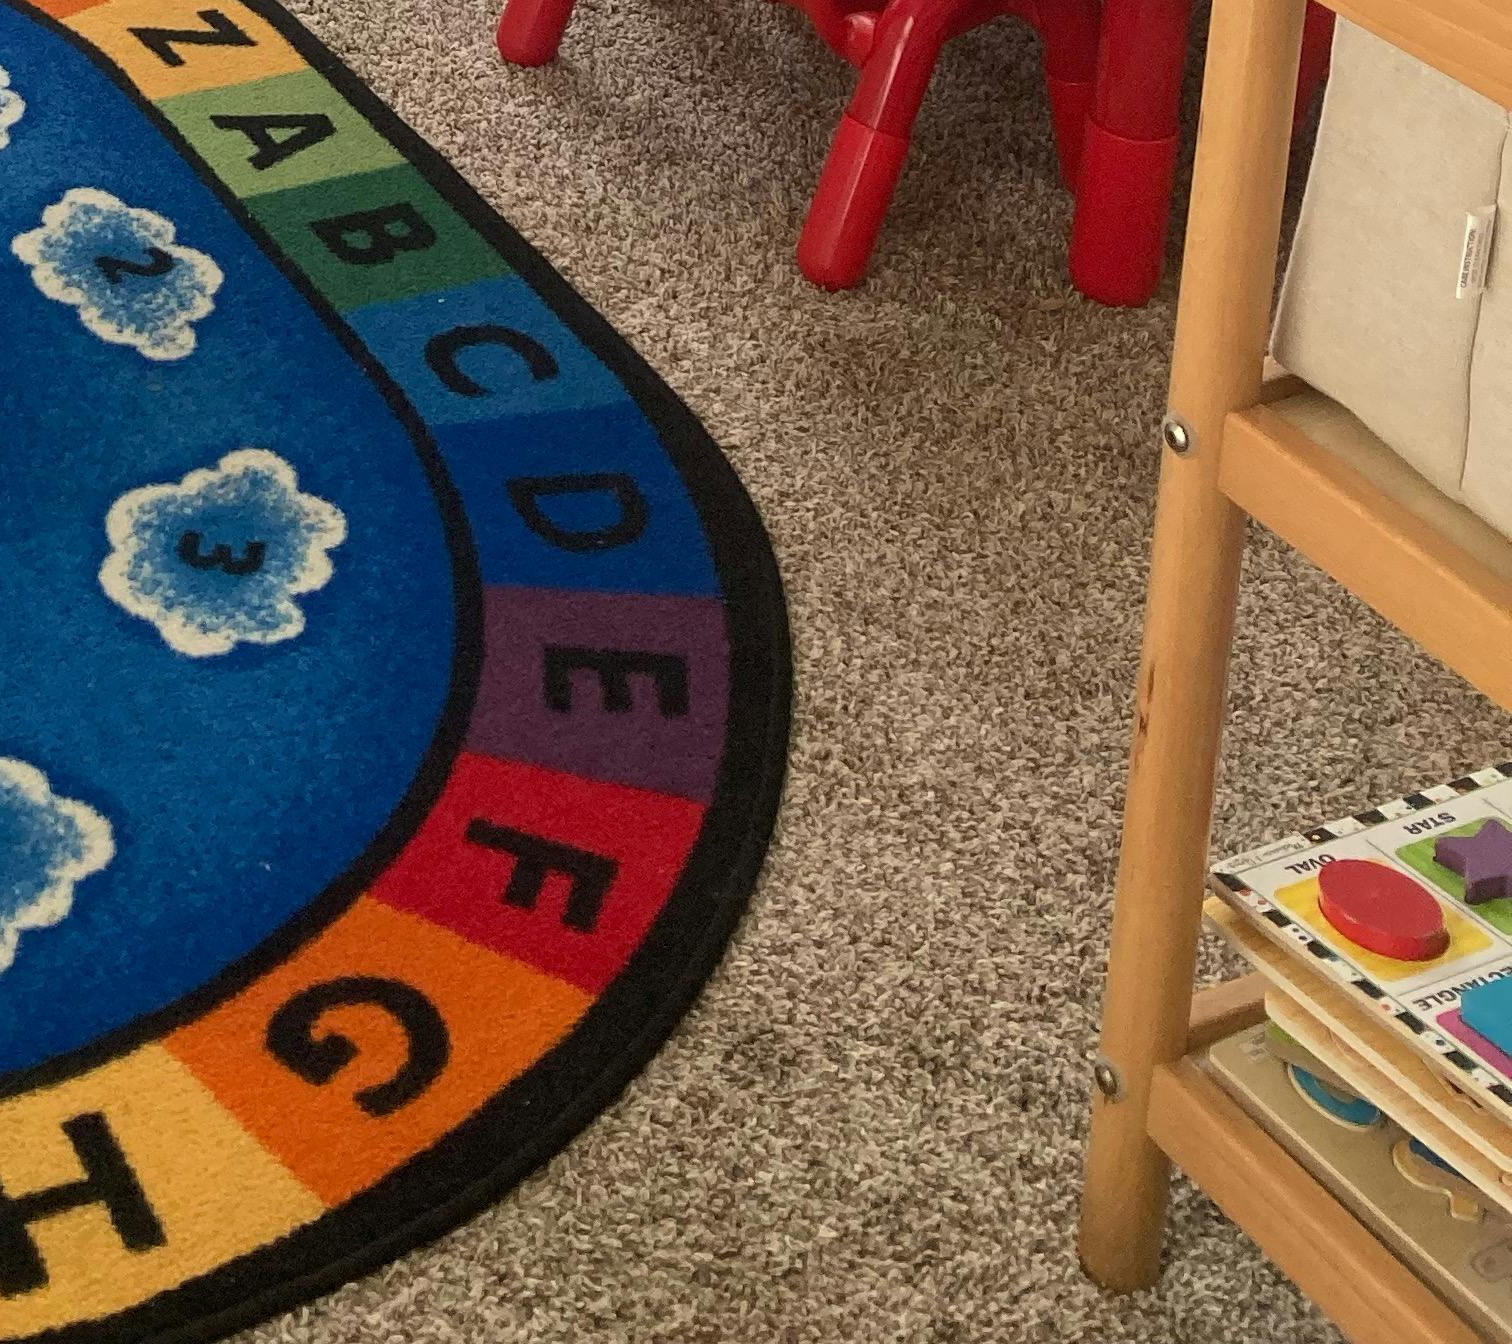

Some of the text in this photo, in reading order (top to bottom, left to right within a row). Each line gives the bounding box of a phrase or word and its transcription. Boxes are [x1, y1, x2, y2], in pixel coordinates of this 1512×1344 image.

[131, 10, 259, 67] Z
[211, 113, 338, 170] A
[311, 201, 437, 266] B
[95, 246, 174, 285] 2
[424, 324, 559, 399] C
[507, 472, 652, 552] D
[176, 531, 266, 575] 3
[542, 646, 688, 720] E
[1403, 811, 1457, 836] STAR
[465, 820, 619, 930] F
[1284, 853, 1337, 874] OVAL
[264, 976, 453, 1118] G
